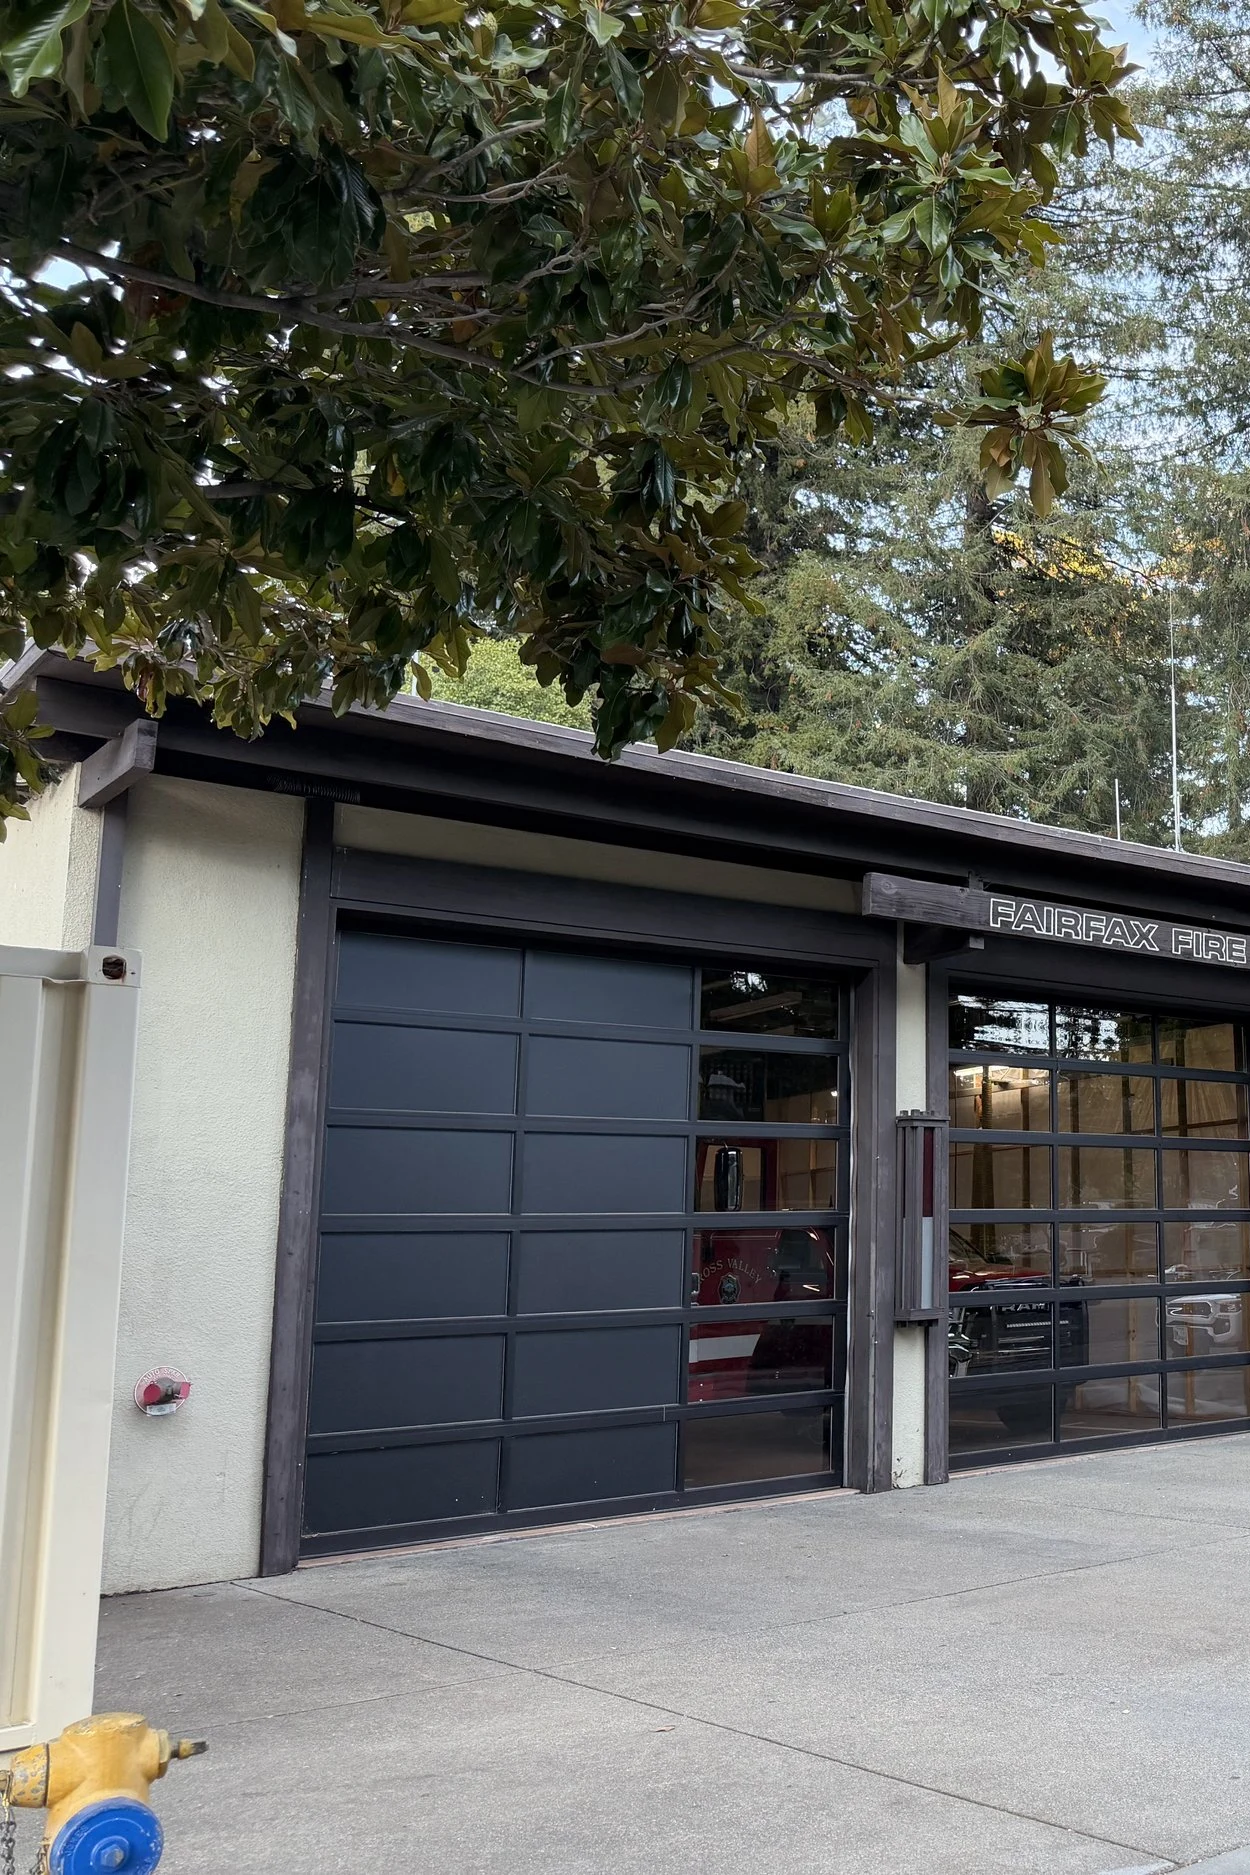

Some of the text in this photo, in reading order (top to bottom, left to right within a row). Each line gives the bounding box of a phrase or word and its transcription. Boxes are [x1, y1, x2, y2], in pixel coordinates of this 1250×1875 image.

[990, 898, 1159, 951] FAIRFAX
[1172, 928, 1247, 963] FIRE
[727, 1258, 761, 1284] VALLEY
[143, 1369, 160, 1382] AUTO
